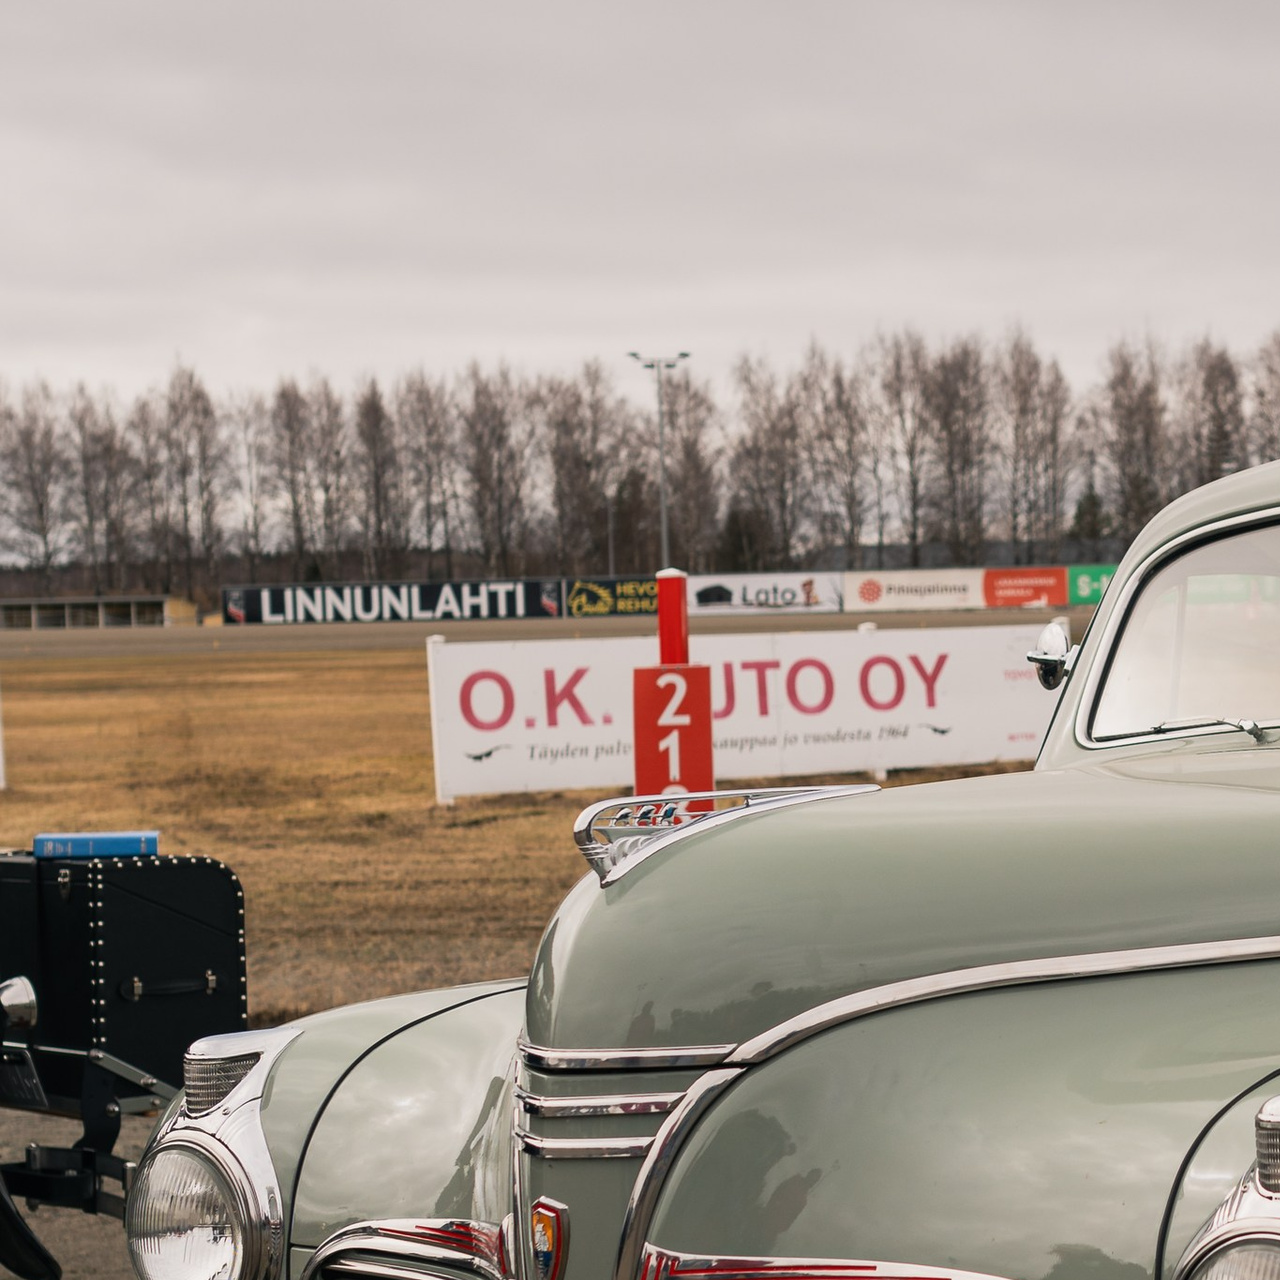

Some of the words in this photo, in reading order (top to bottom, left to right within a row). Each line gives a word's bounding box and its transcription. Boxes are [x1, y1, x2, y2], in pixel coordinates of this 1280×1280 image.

[260, 581, 525, 623] LINNUNLAHTI
[616, 581, 659, 596] HEVO
[617, 598, 659, 612] REHU
[458, 666, 614, 732] O.K.
[711, 656, 835, 718] UTO
[859, 653, 949, 711] OY
[528, 742, 590, 765] Täyden
[594, 740, 632, 762] palv
[782, 730, 799, 749] jo
[803, 726, 872, 744] vuodesta
